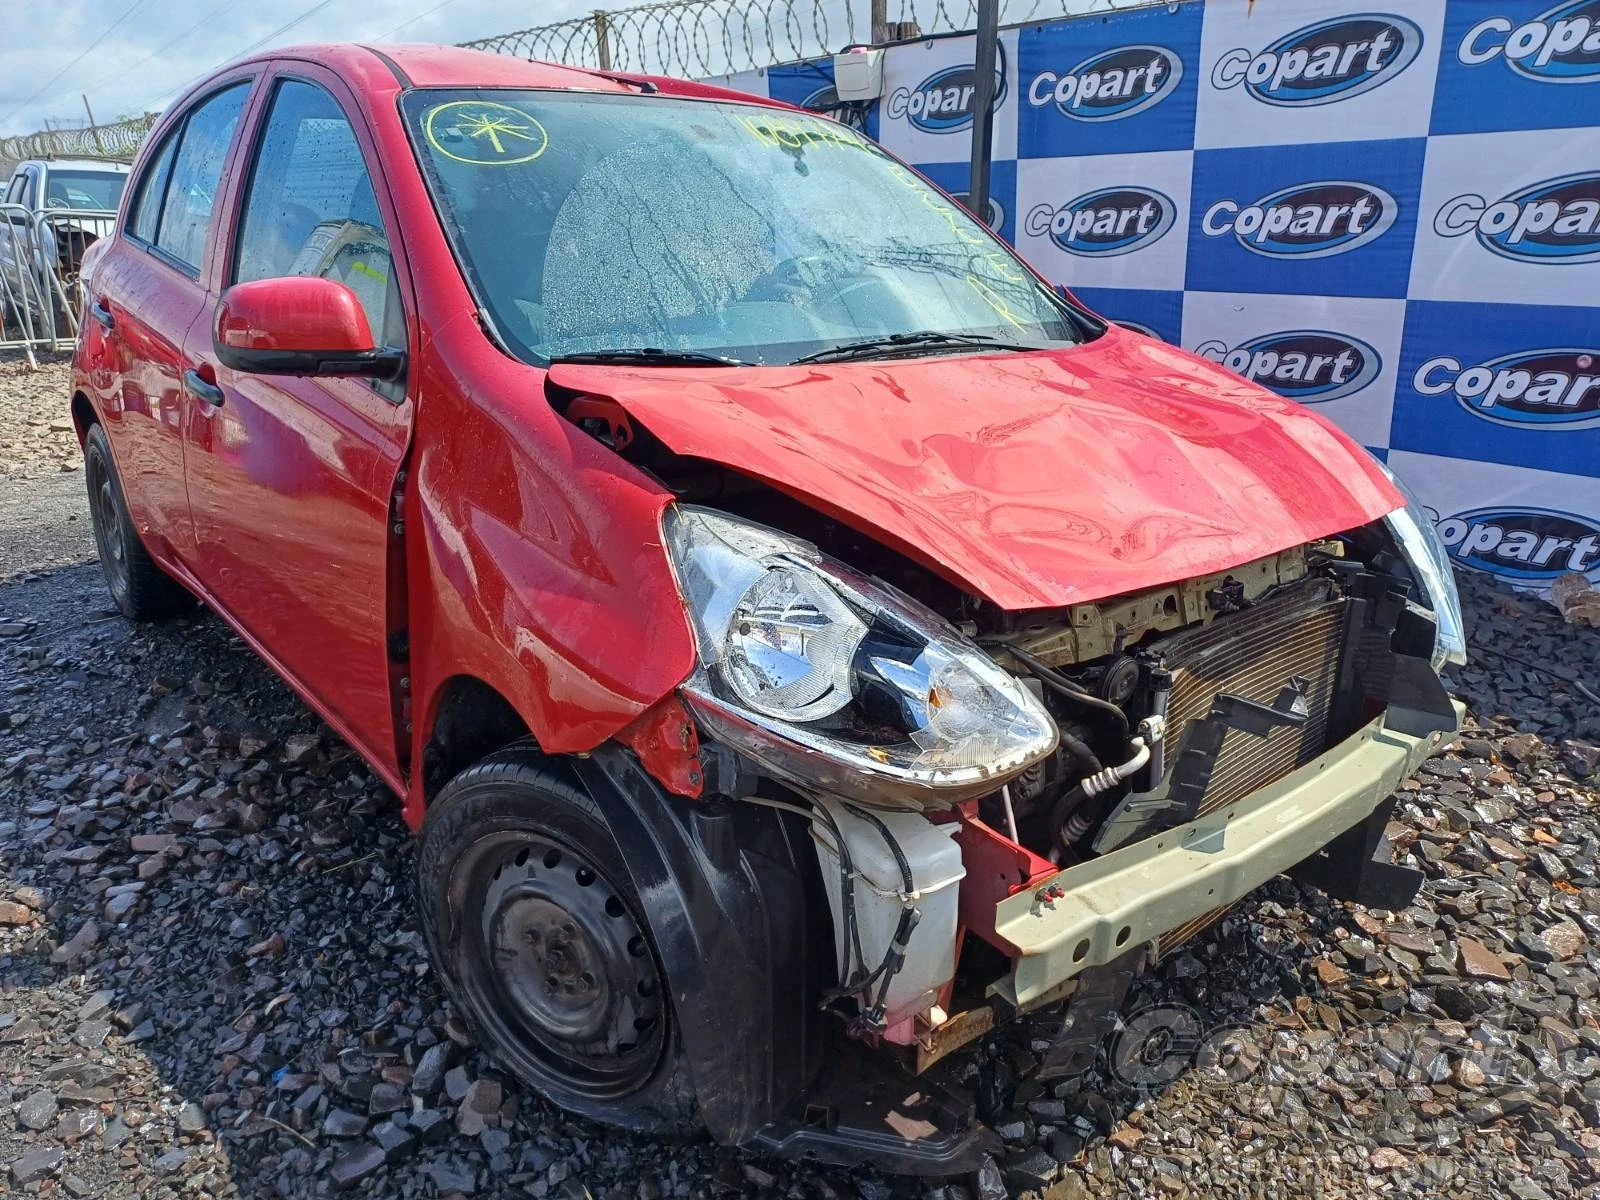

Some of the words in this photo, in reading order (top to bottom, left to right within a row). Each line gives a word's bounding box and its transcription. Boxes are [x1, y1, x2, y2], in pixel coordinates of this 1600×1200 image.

[1211, 27, 1396, 92] Copart
[1457, 15, 1600, 68] Cop
[887, 83, 977, 121] Copar
[1028, 54, 1168, 107] Copart
[1025, 198, 1160, 243] Copart
[1201, 193, 1375, 244] Copart
[1433, 193, 1600, 246] Copa
[1411, 356, 1600, 408] Copar
[1424, 505, 1600, 572] opart
